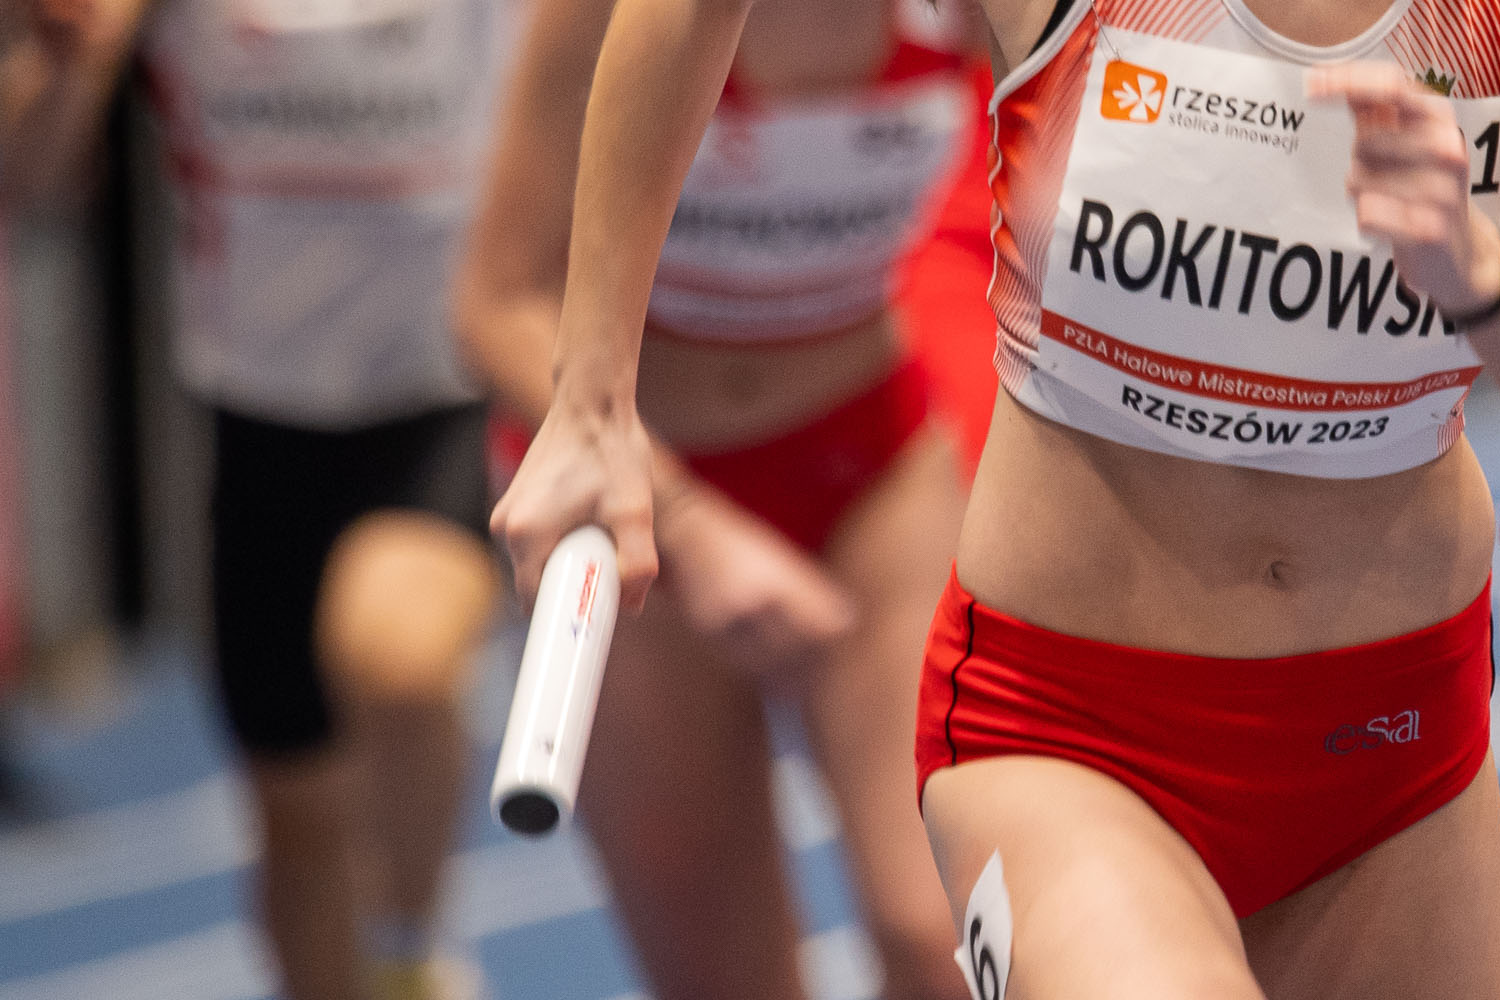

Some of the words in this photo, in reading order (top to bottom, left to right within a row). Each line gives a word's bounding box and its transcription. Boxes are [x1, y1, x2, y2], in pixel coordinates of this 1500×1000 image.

[1169, 112, 1220, 134] stolica
[1225, 123, 1300, 154] innowacji
[1171, 85, 1305, 133] rzeszów
[1113, 345, 1194, 387] Halowe
[1198, 370, 1328, 408] Mistrzostwa
[1331, 388, 1391, 407] Polski
[1121, 383, 1304, 445] RZESZÓW
[1306, 414, 1391, 444] 2023
